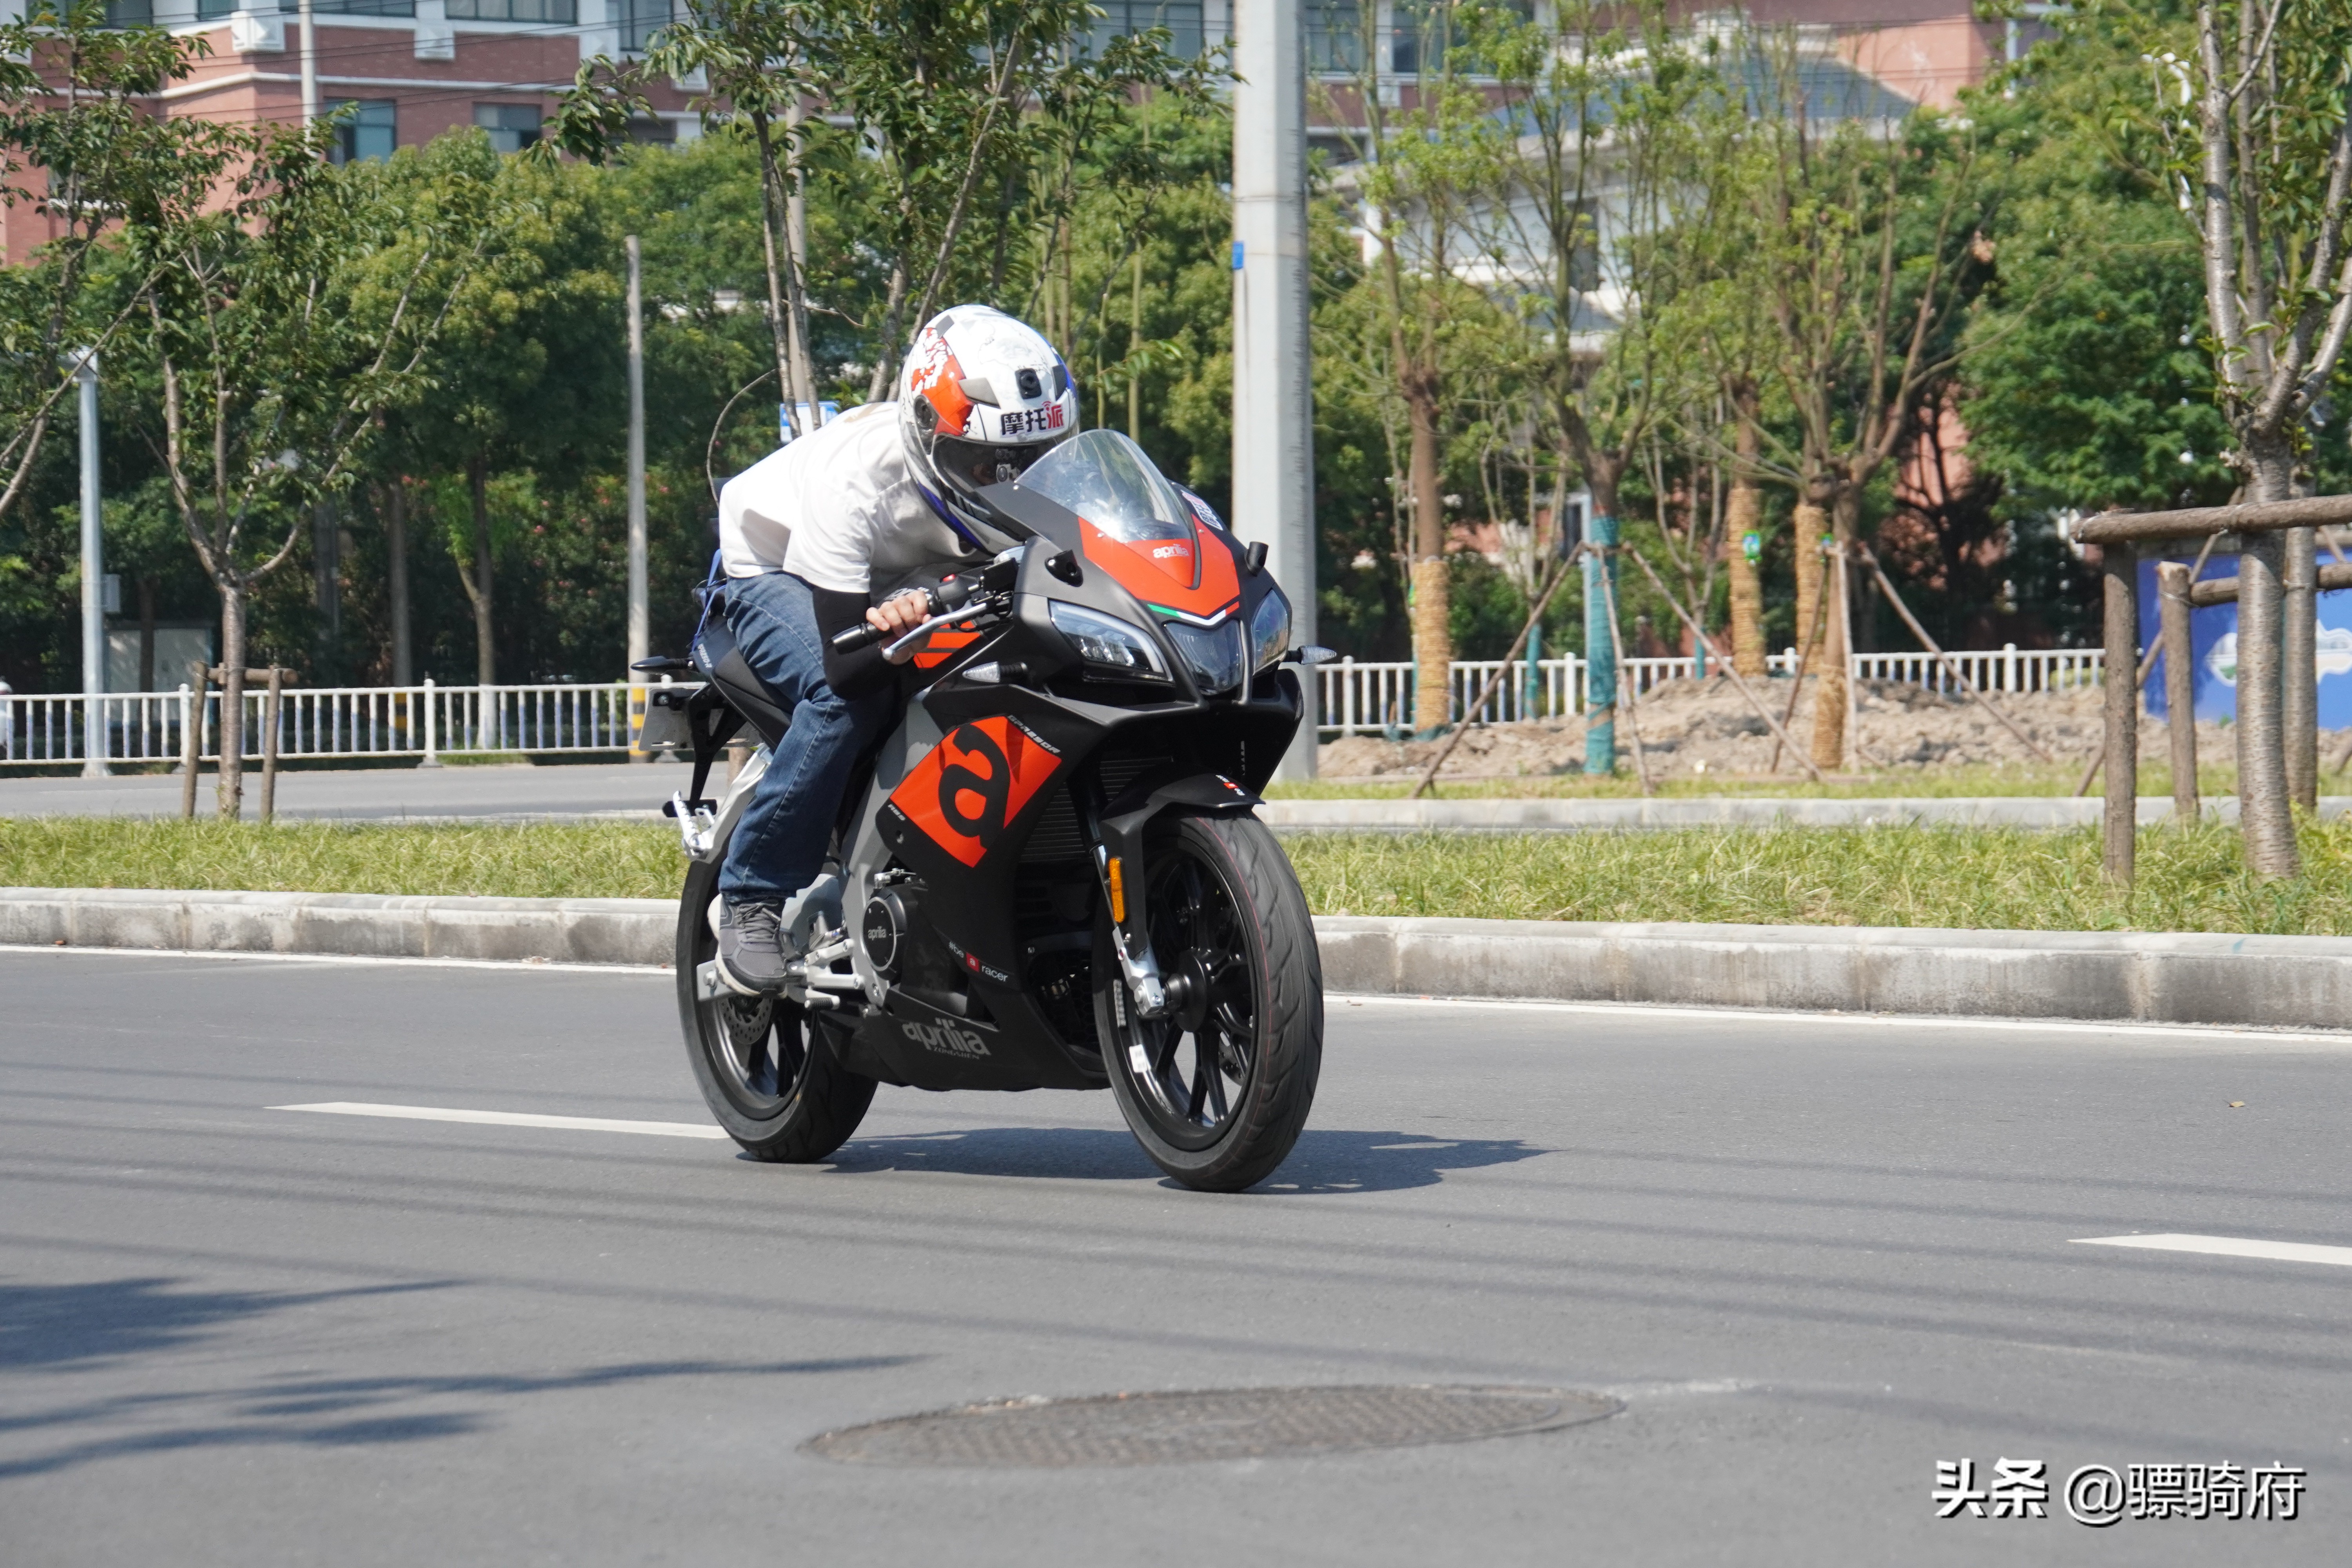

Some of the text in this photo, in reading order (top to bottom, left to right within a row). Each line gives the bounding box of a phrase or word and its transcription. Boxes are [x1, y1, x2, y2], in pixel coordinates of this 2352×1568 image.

[1001, 401, 1063, 435] 摩托派
[1153, 543, 1189, 558] aprilia
[867, 926, 886, 940] aprilia
[949, 942, 964, 958] #be
[982, 965, 1008, 982] racer
[902, 1017, 992, 1054] aprilia
